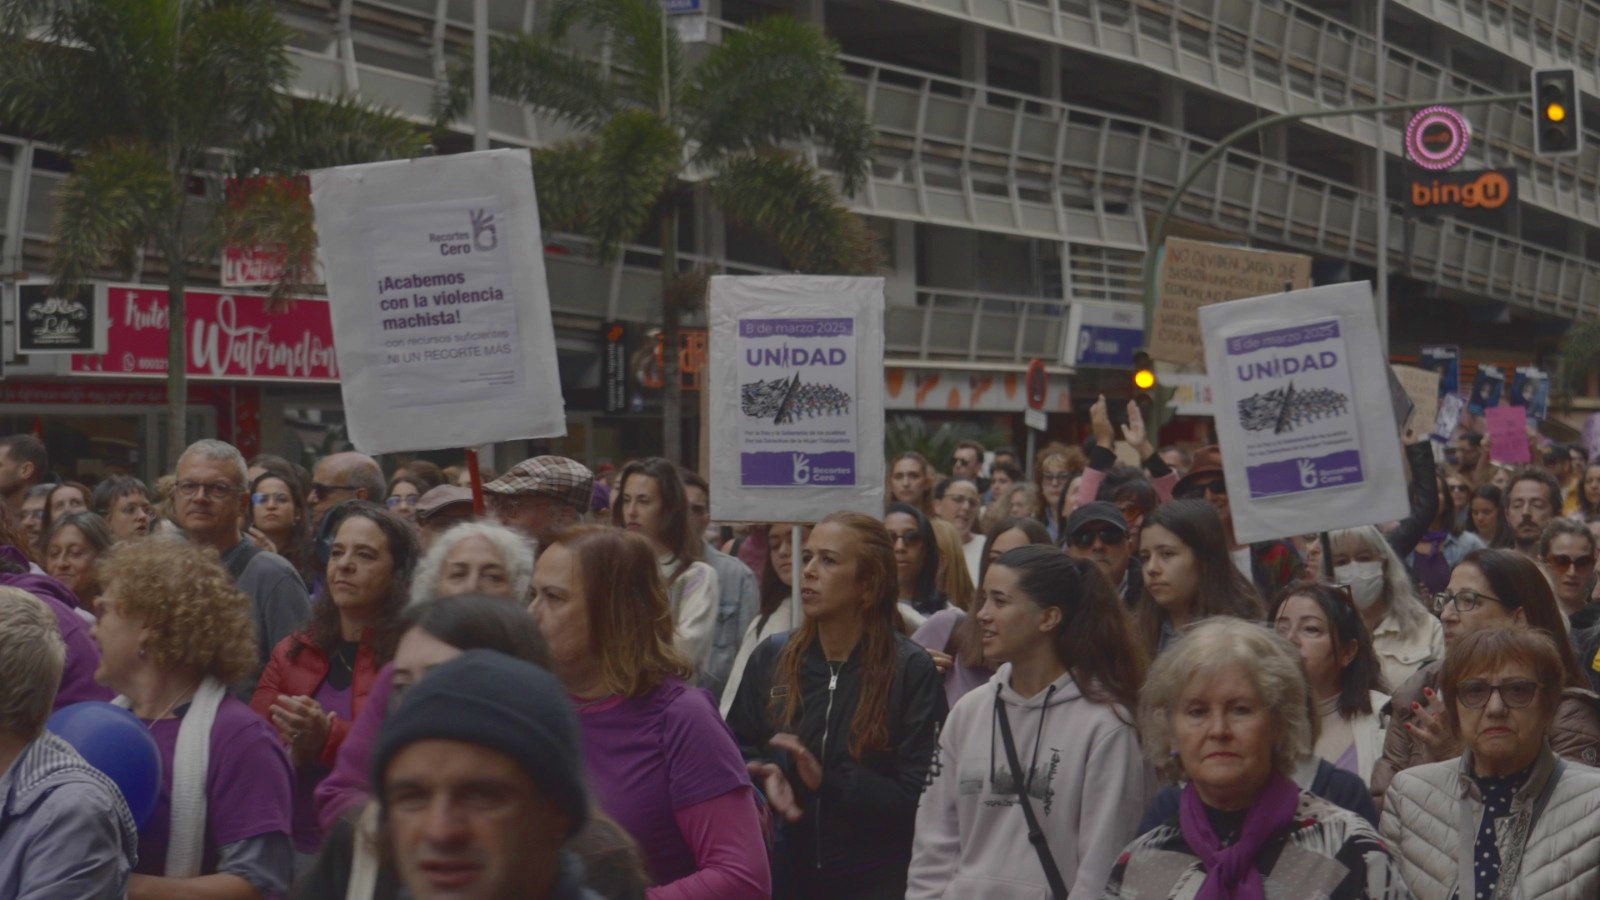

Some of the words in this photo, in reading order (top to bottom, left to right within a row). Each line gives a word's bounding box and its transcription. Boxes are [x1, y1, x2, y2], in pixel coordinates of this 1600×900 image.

[429, 232, 470, 243] Recortes
[440, 243, 471, 256] Cero
[377, 272, 466, 294] ¡Acabemos
[380, 297, 409, 311] con
[412, 294, 429, 308] la
[433, 287, 504, 306] violencia
[382, 310, 462, 331] machista!
[745, 323, 754, 334] 8
[756, 322, 773, 334] de
[775, 323, 814, 334] marzo
[816, 321, 847, 334] 2025
[192, 295, 337, 378] Watermelon
[385, 338, 405, 348] con
[407, 334, 452, 346] recursos
[454, 330, 510, 343] suficientes
[387, 354, 400, 364] NI
[403, 351, 421, 363] UN
[424, 346, 481, 361] RECORTE
[746, 344, 847, 367] UNIDAD
[1237, 351, 1338, 382] UNIDAD
